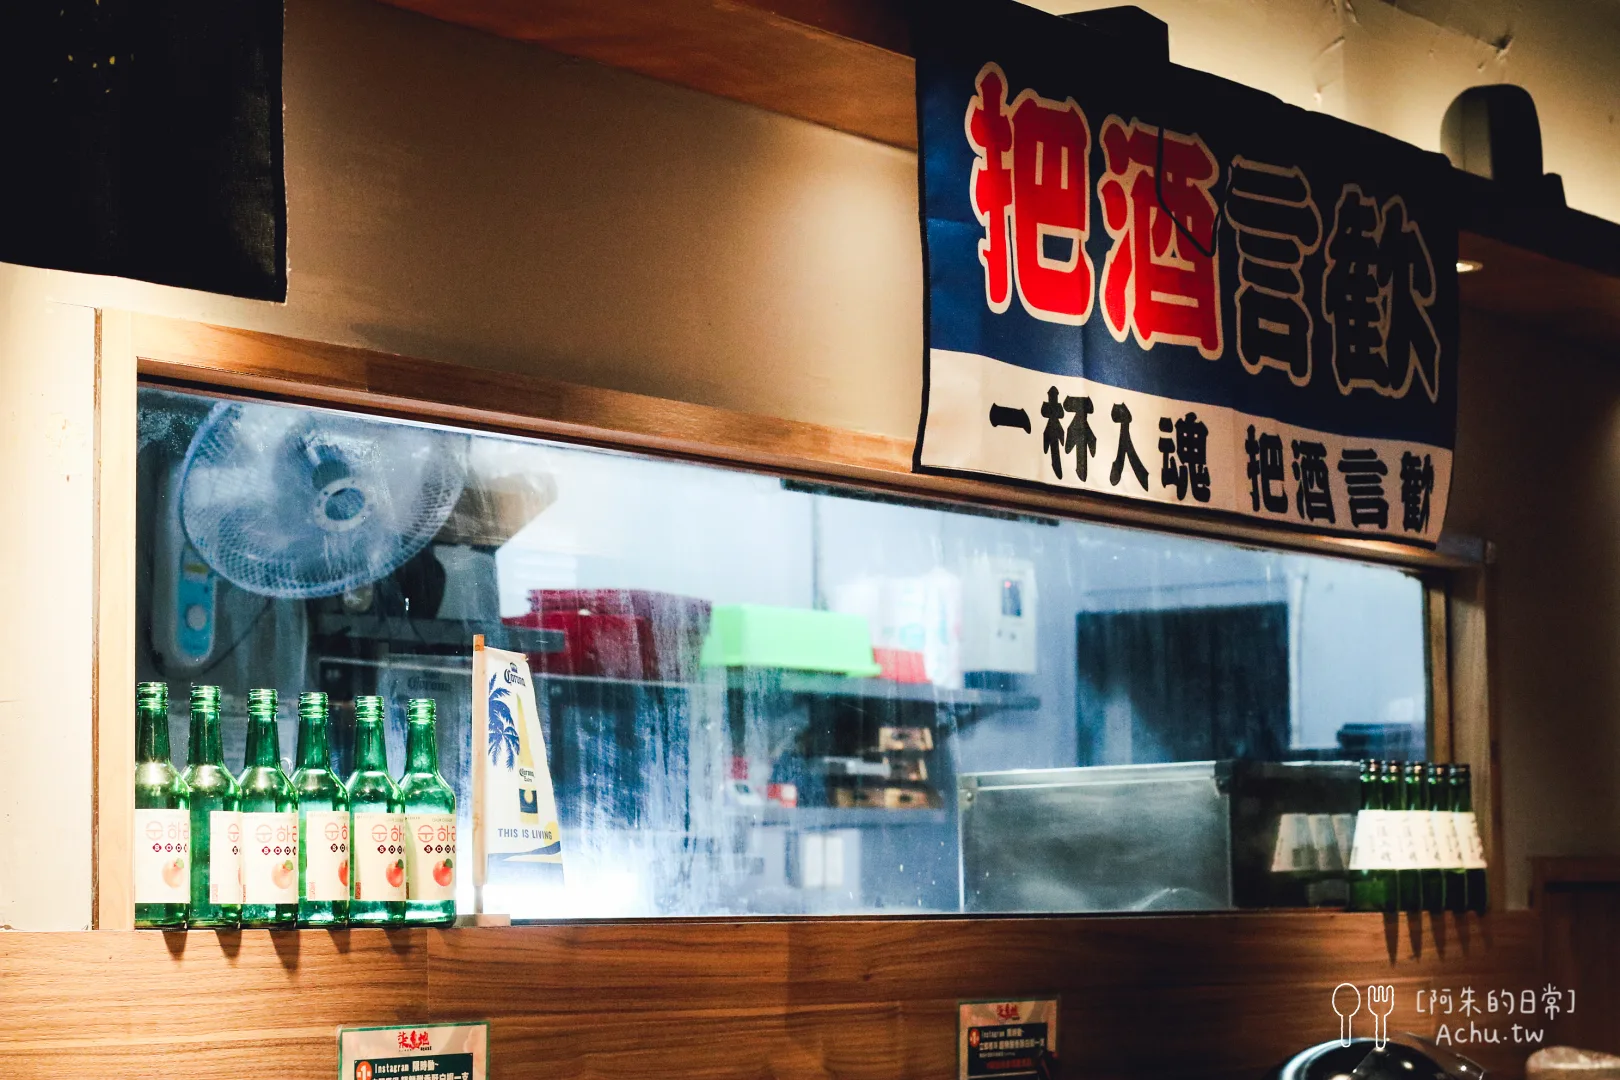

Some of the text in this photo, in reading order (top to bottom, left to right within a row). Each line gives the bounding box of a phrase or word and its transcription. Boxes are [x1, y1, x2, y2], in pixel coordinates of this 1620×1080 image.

[989, 386, 1211, 502] 一杯入魂
[503, 668, 527, 687] Corona
[498, 828, 553, 840] THIS IS LIVING
